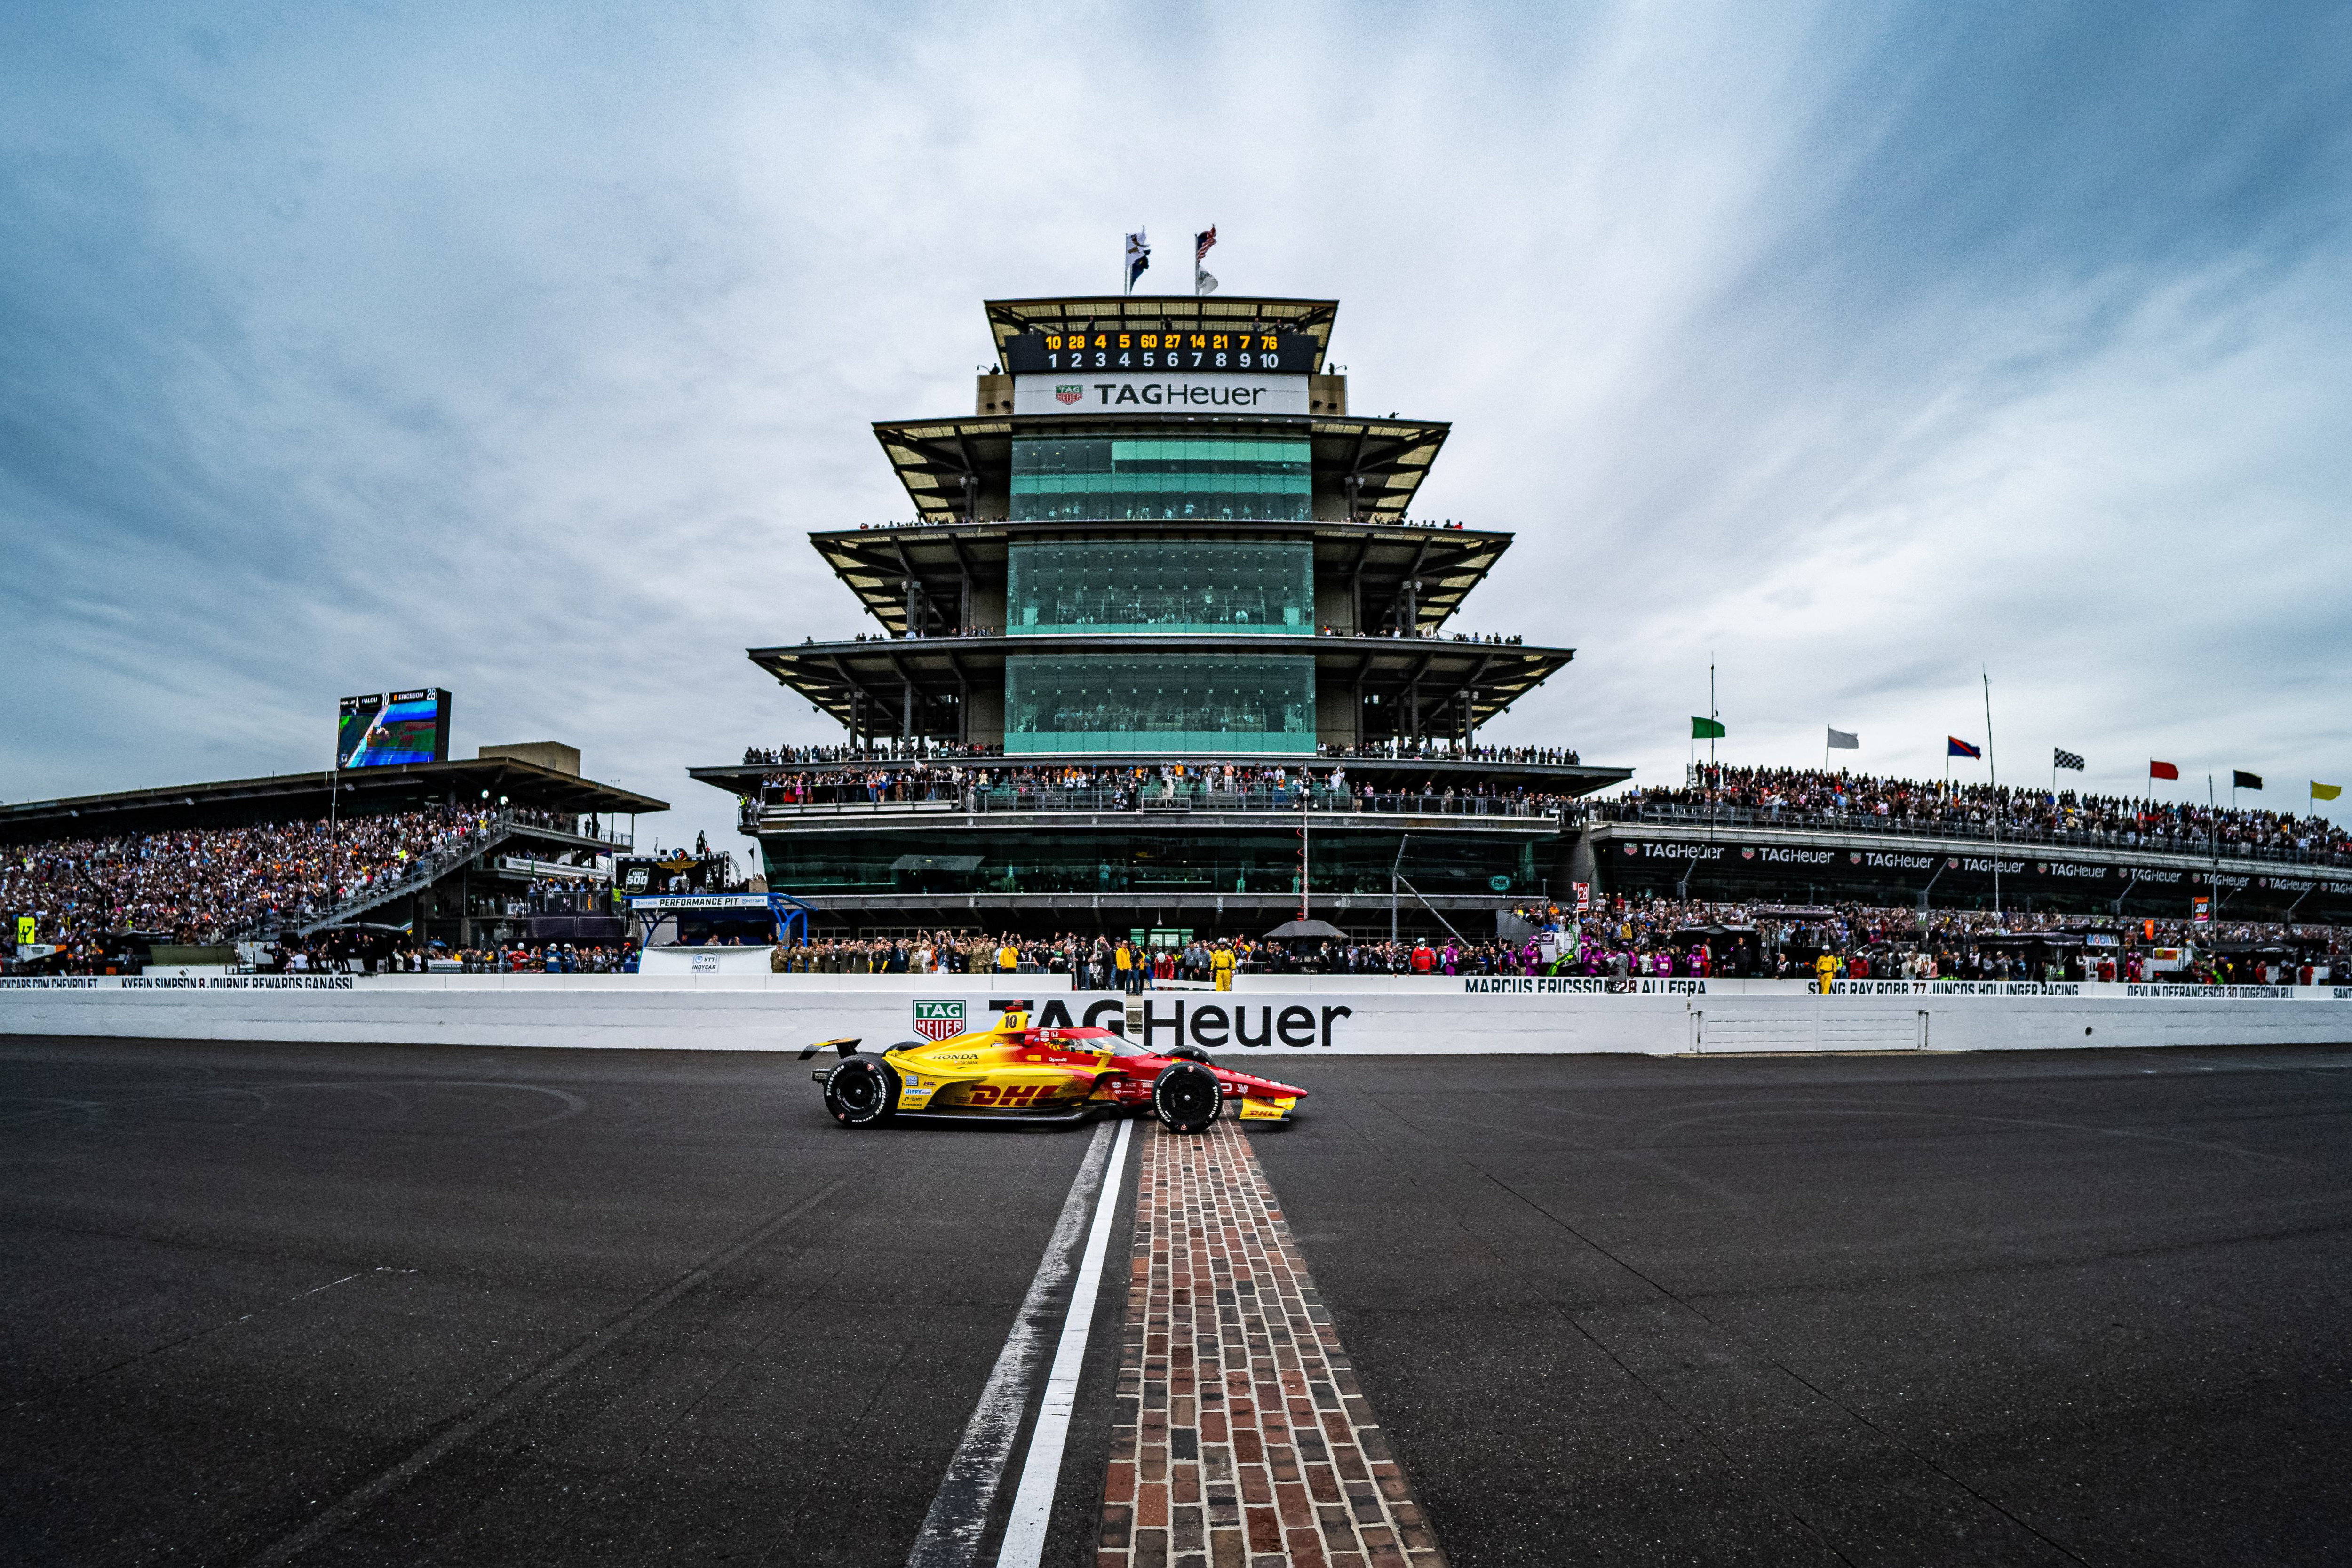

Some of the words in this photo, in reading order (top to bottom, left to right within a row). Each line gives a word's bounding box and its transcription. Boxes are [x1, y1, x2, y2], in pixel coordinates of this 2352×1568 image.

[1046, 335, 1061, 349] 10
[1069, 335, 1085, 349] 28
[1095, 335, 1107, 348] 4
[1120, 335, 1130, 348] 5
[1141, 335, 1157, 348] 60
[1165, 335, 1181, 348] 27
[1190, 335, 1205, 349] 14
[1213, 335, 1228, 349] 21
[1240, 335, 1250, 349] 7
[1261, 336, 1278, 350] 76
[1049, 354, 1057, 368] 1
[1071, 353, 1082, 367] 2
[1096, 352, 1106, 367] 3
[1119, 352, 1130, 366] 4
[1144, 352, 1154, 366] 5
[1168, 352, 1178, 366] 6
[1192, 352, 1202, 367] 7
[1216, 353, 1227, 367] 8
[1240, 353, 1251, 367] 9
[1260, 354, 1279, 368] 10
[1058, 393, 1081, 403] HEUER
[382, 692, 389, 706] 10
[398, 692, 423, 700] ERICSSON
[427, 688, 436, 700] 28
[627, 876, 648, 884] 500
[1579, 887, 1588, 899] 28
[660, 898, 723, 907] PERFORMANCE
[2195, 903, 2208, 913] 30
[121, 977, 152, 988] KYFFIN
[155, 977, 197, 988] SIMPSON
[252, 977, 302, 988] REWARDS
[306, 977, 353, 989] GANASSI
[1465, 979, 1533, 993] MARCUS
[1642, 980, 1706, 994] ALLEGRA
[1808, 982, 1845, 994] STNG
[1850, 982, 1873, 994] RAY
[1912, 983, 1926, 994] 77
[2041, 984, 2078, 995] RACING
[2240, 987, 2279, 998] DOGECOIN
[919, 1004, 960, 1017] TAG
[1005, 1014, 1017, 1029] 10
[918, 1020, 961, 1041] HEUER
[826, 1065, 845, 1097] Firestone
[875, 1075, 886, 1115] FIREHAWK
[970, 1085, 1065, 1106] DHL
[1209, 1085, 1219, 1119] Firestone
[1156, 1088, 1171, 1122] FIREHAWK
